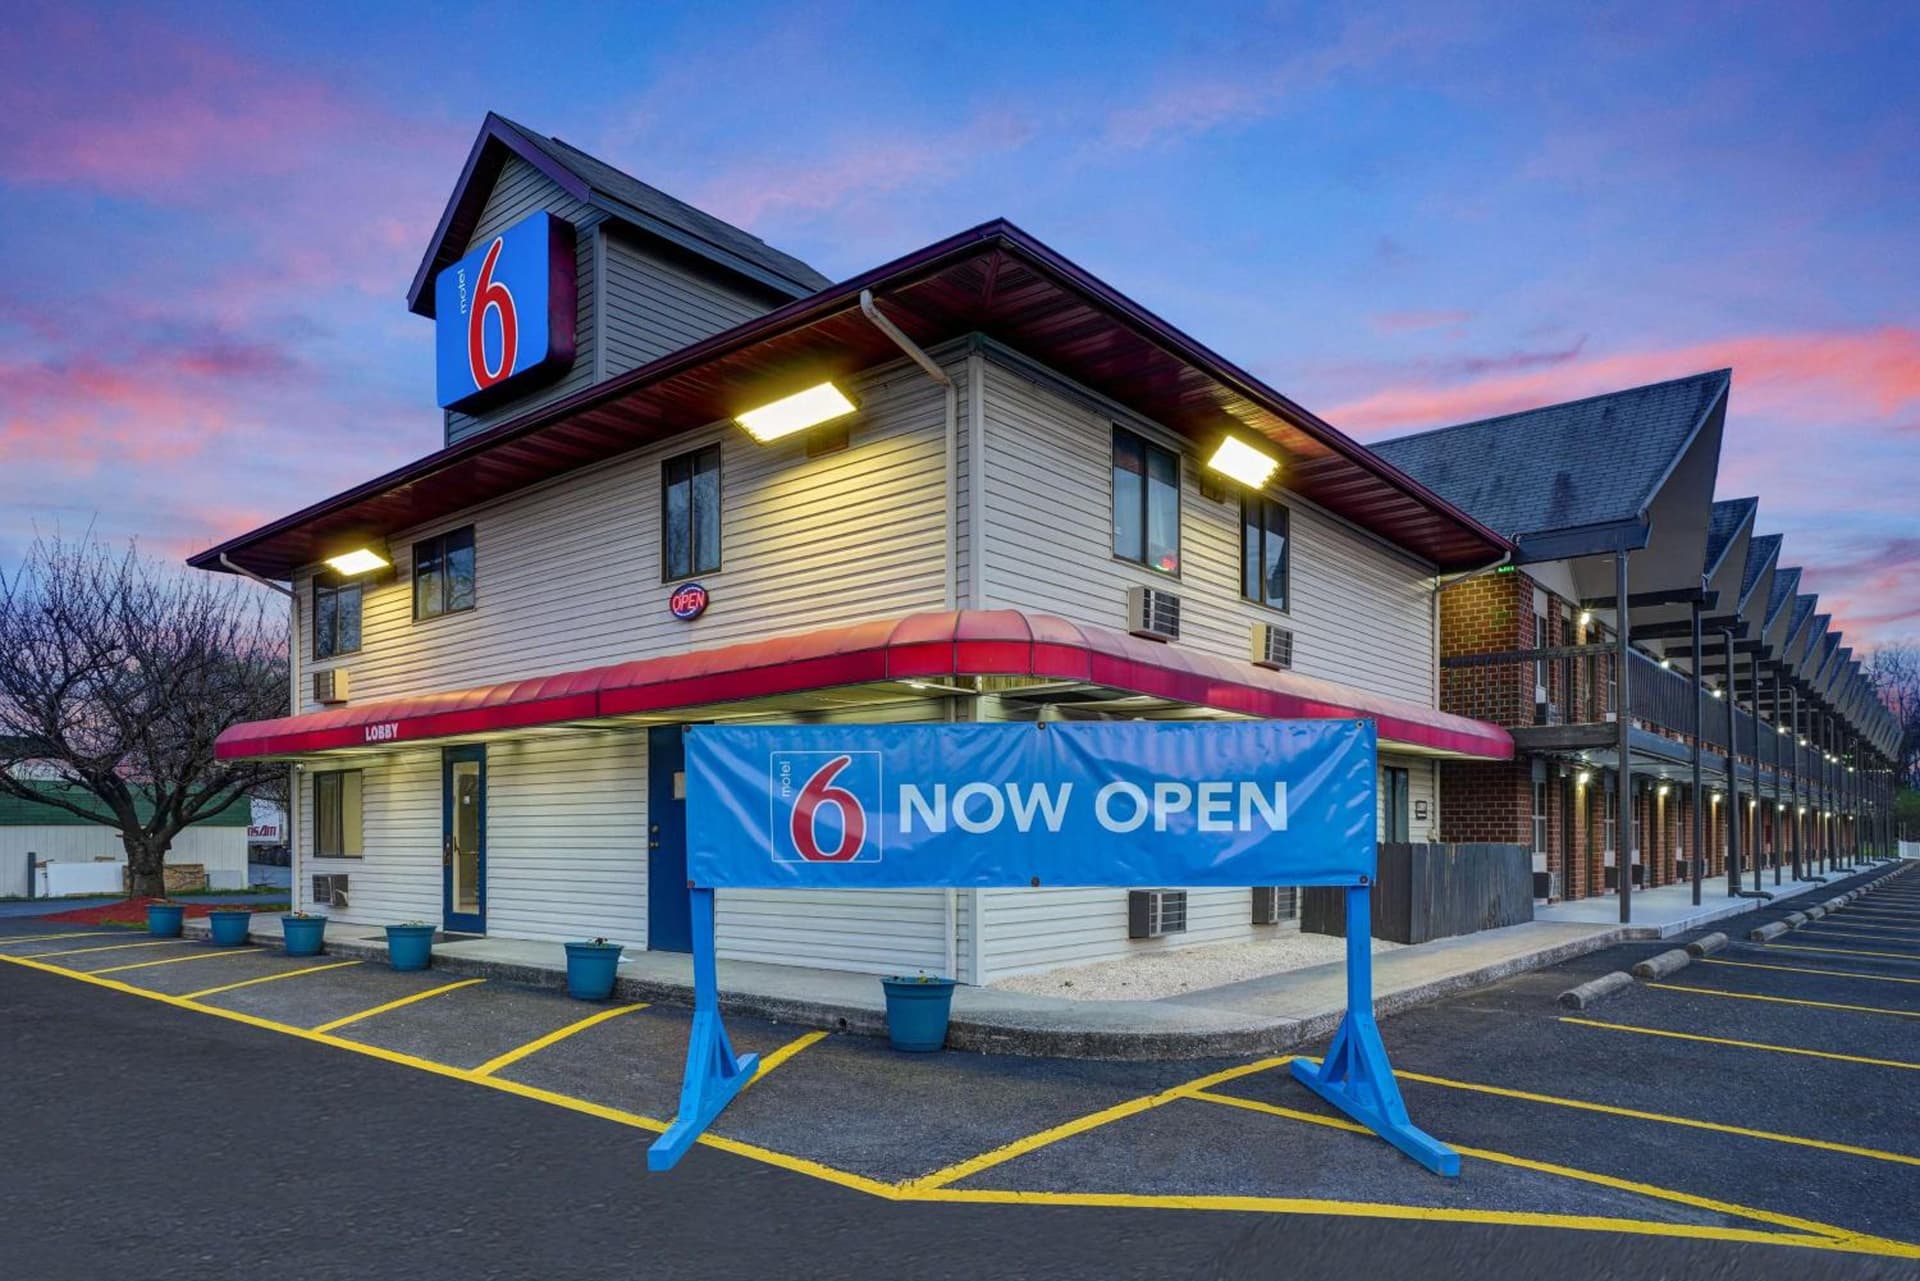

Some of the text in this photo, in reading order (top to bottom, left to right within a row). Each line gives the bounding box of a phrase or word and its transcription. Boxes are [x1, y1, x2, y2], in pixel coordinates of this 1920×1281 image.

[457, 236, 518, 391] motel 6
[672, 592, 705, 612] OPEN
[365, 722, 399, 741] LOBBY
[779, 755, 867, 861] motel 6
[899, 781, 1288, 833] NOW OPEN
